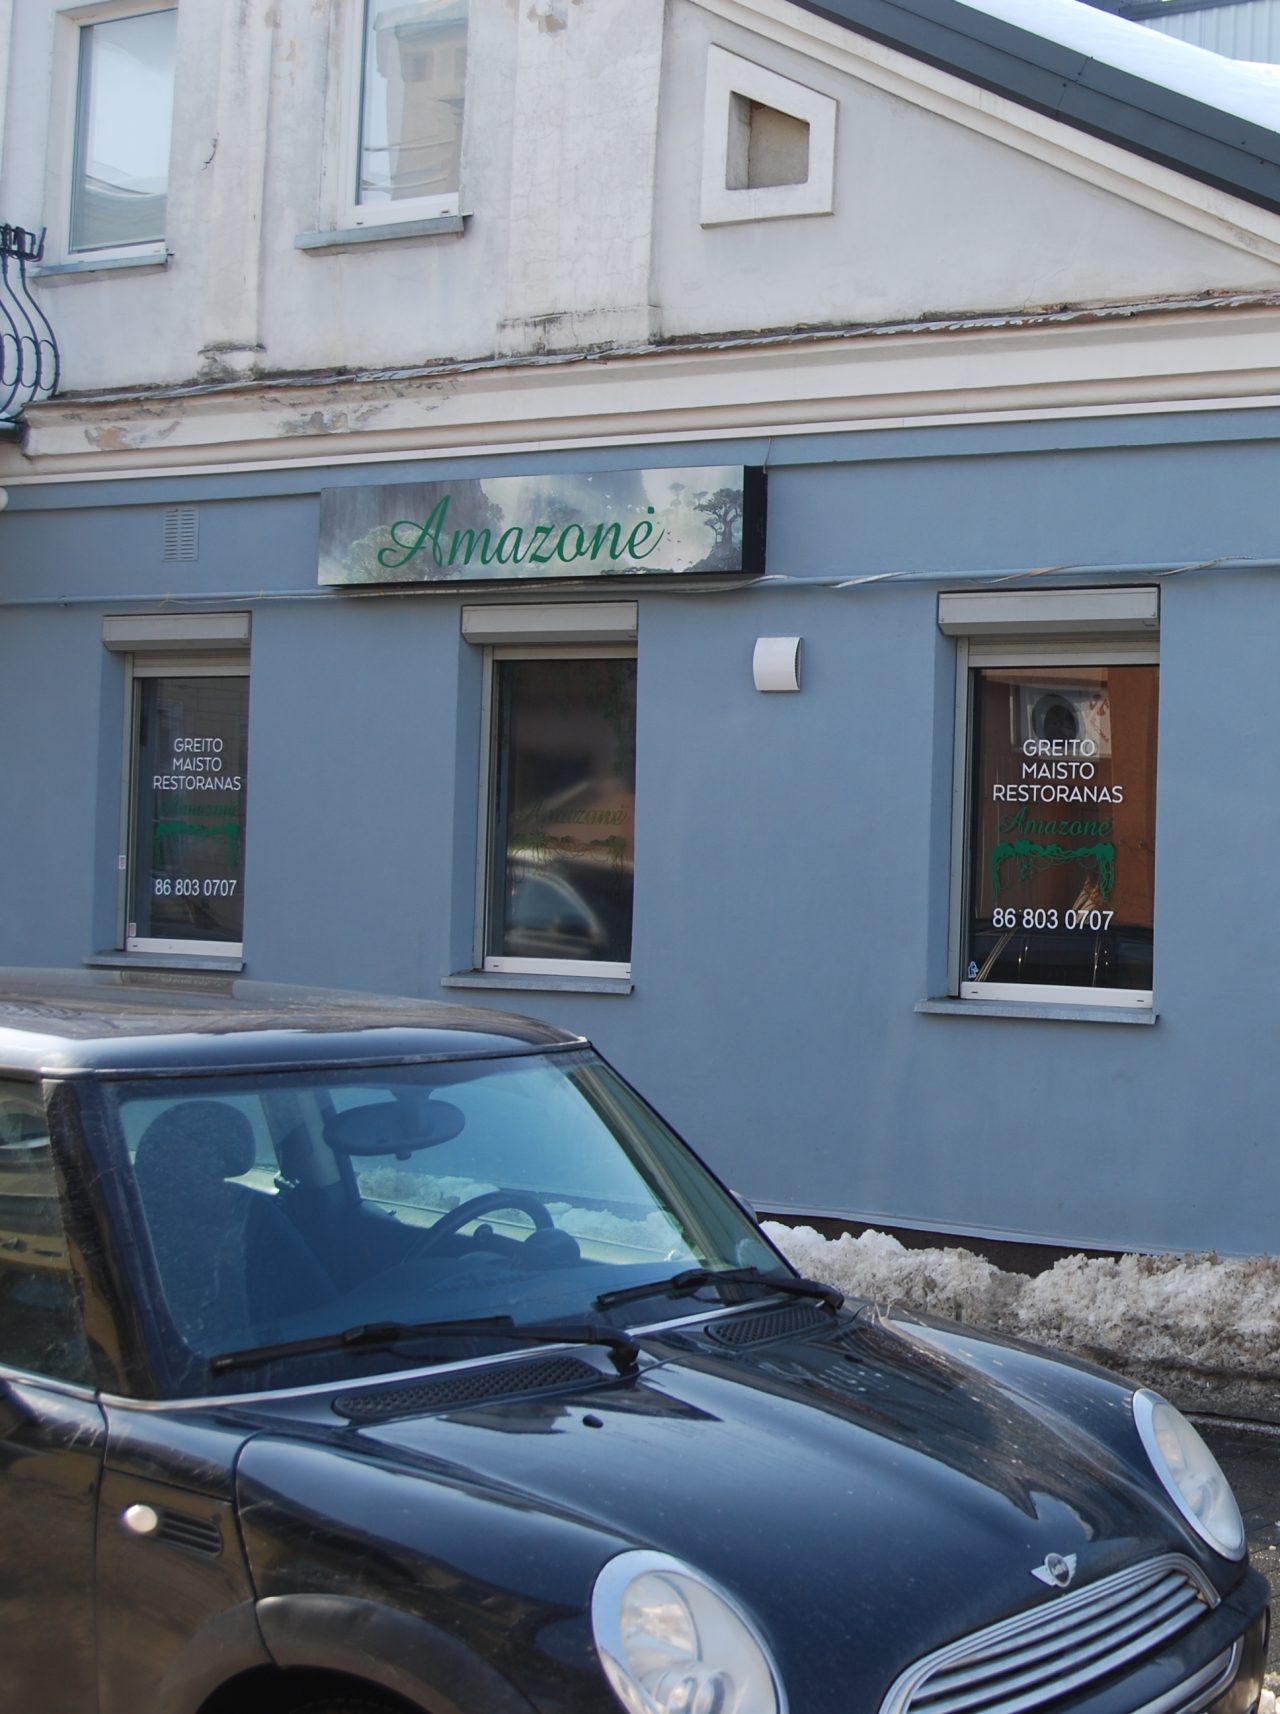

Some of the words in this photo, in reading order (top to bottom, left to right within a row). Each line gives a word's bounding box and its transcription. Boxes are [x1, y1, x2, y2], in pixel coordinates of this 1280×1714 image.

[377, 494, 666, 569] Amazonė
[173, 737, 224, 753] GREITO
[1022, 738, 1096, 757] GREITO
[172, 756, 222, 772] MAISTO
[1022, 761, 1095, 780] MAISTO
[153, 775, 241, 791] RESTORANAS
[993, 784, 1124, 804] RESTORANAS
[155, 878, 172, 896] 86
[175, 878, 200, 896] 803
[203, 879, 237, 897] 0707
[992, 907, 1016, 928] 86
[1022, 908, 1059, 929] 803
[1064, 909, 1114, 931] 0707
